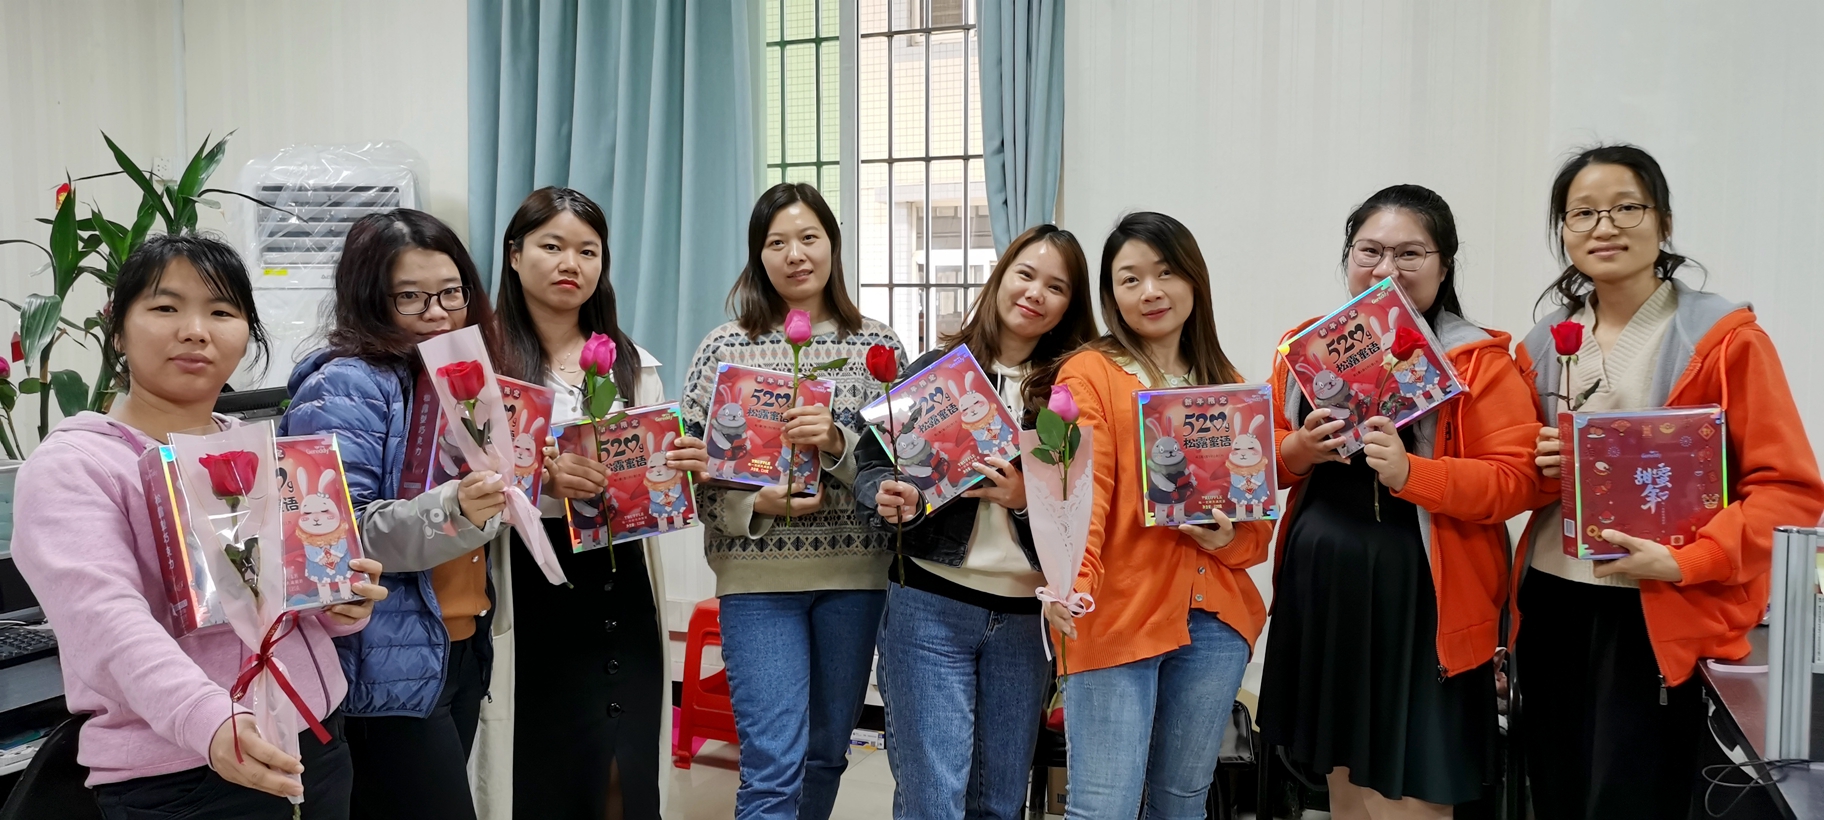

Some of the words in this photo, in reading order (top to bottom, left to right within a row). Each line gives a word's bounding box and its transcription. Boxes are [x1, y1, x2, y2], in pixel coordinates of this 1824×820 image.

[1319, 309, 1358, 337] 新年限定
[1335, 341, 1381, 373] 松露蜜语
[1184, 396, 1228, 407] 新年限定
[918, 403, 958, 433] 松露蜜语
[1183, 435, 1231, 449] 松露蜜语
